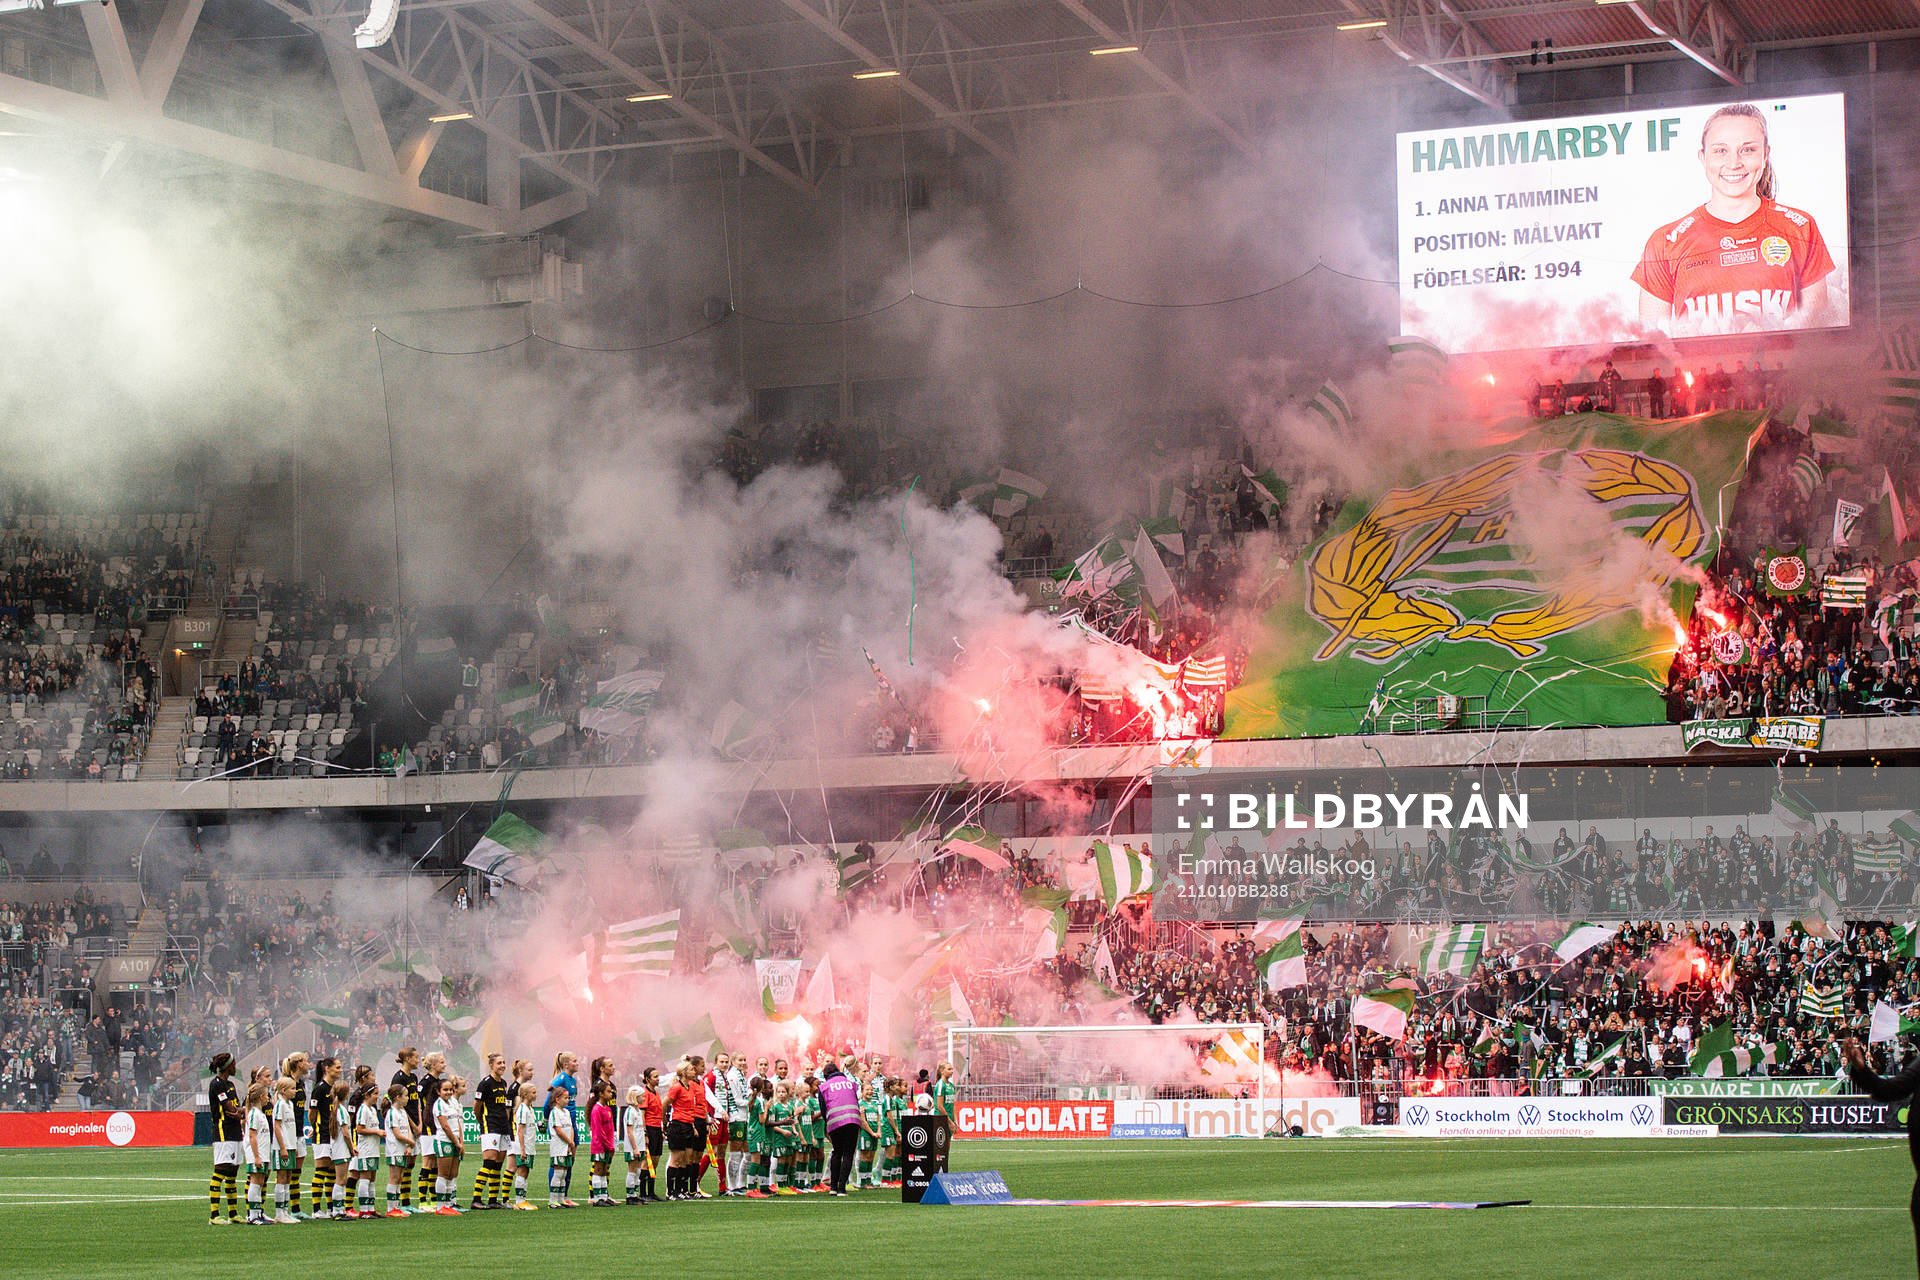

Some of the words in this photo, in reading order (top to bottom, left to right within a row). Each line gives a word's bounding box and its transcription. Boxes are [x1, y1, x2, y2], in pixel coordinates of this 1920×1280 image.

[1411, 122, 1632, 173] HAMMARBY
[1647, 117, 1681, 152] IF
[1415, 201, 1432, 217] 1.
[1438, 196, 1489, 215] ANNA
[1494, 186, 1598, 210] TAMMINEN
[1414, 232, 1507, 253] POSITION:
[1514, 222, 1603, 245] MÅLVAKT
[1413, 261, 1526, 289] FÖDELSEÅR:
[1534, 261, 1582, 280] 1994
[184, 621, 211, 632] B301
[1686, 727, 1743, 743] NACKA
[119, 960, 149, 972] A101
[829, 1081, 853, 1092] FOTO
[959, 1106, 1107, 1132] CHOCOLATE
[1436, 1110, 1510, 1122] Stockholm
[1548, 1109, 1624, 1122] Stockholm
[1676, 1103, 1804, 1125] GRÖNSAKS
[1809, 1105, 1889, 1125] HUSET
[49, 1123, 105, 1136] marginalen
[109, 1123, 133, 1132] bank
[1439, 1127, 1475, 1135] Handla
[1477, 1127, 1506, 1135] online
